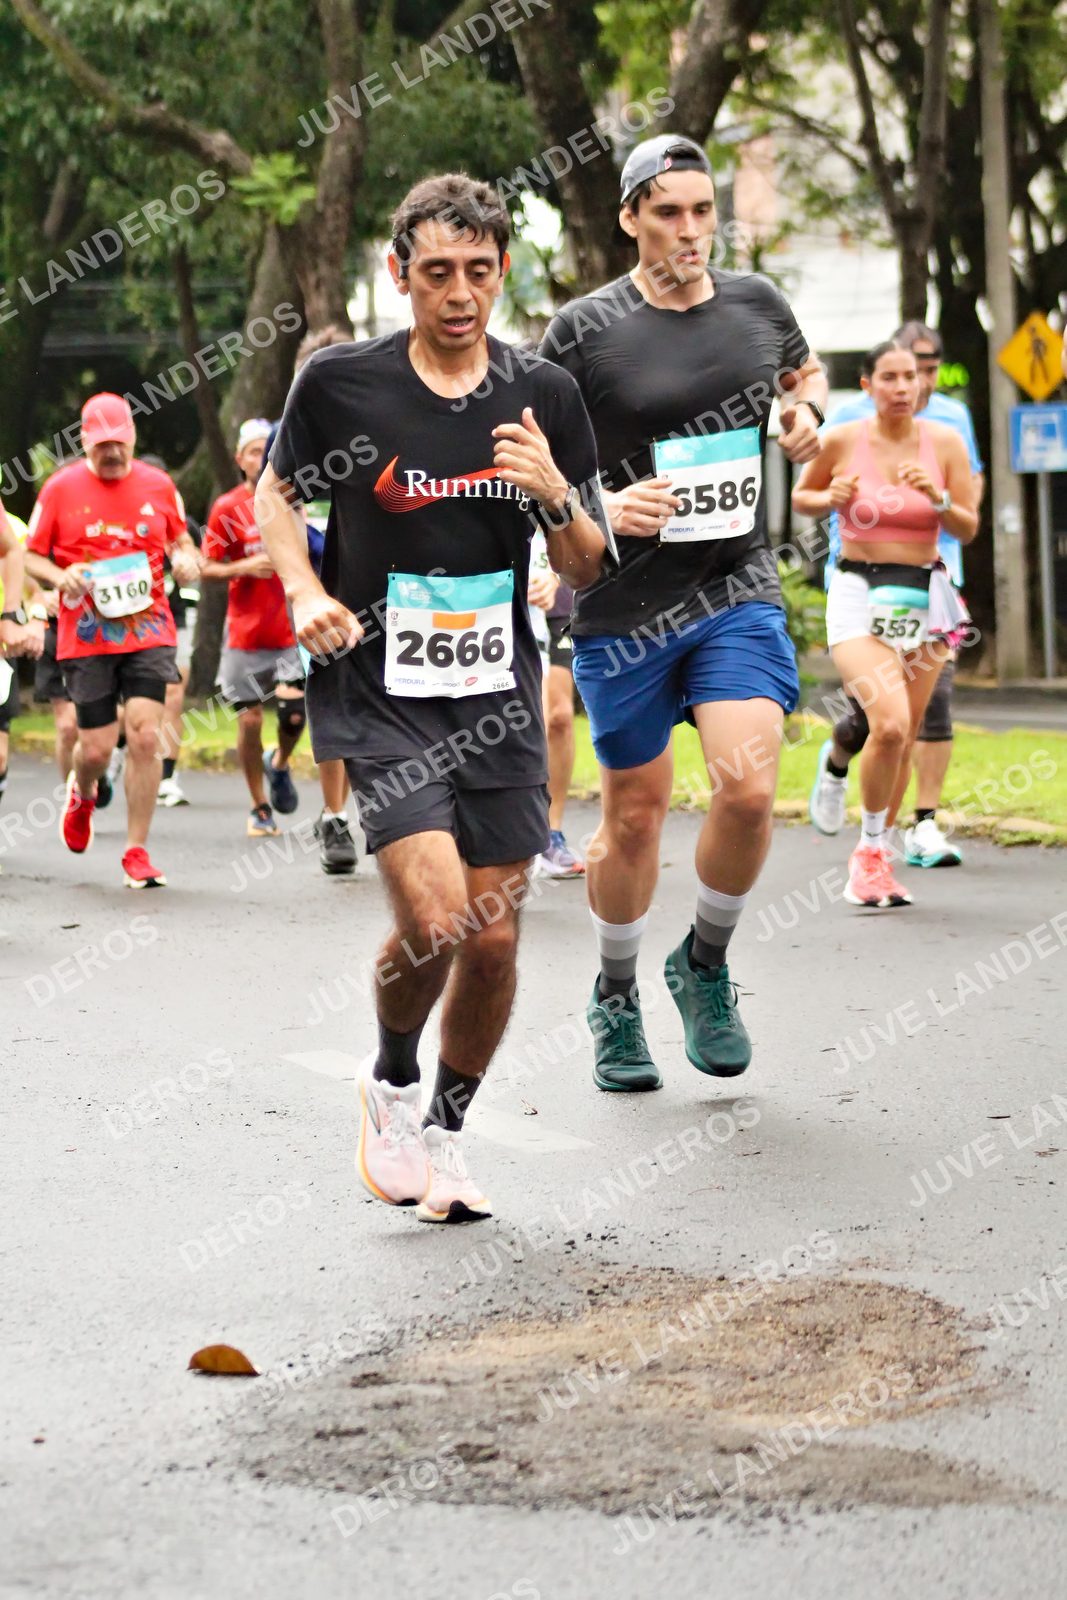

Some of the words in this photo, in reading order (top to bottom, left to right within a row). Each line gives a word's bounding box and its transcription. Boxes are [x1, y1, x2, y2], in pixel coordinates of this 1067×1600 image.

[404, 469, 531, 512] Running
[671, 476, 757, 518] 6586
[99, 579, 148, 605] 3160
[395, 626, 506, 669] 2666
[492, 681, 511, 691] 2666
